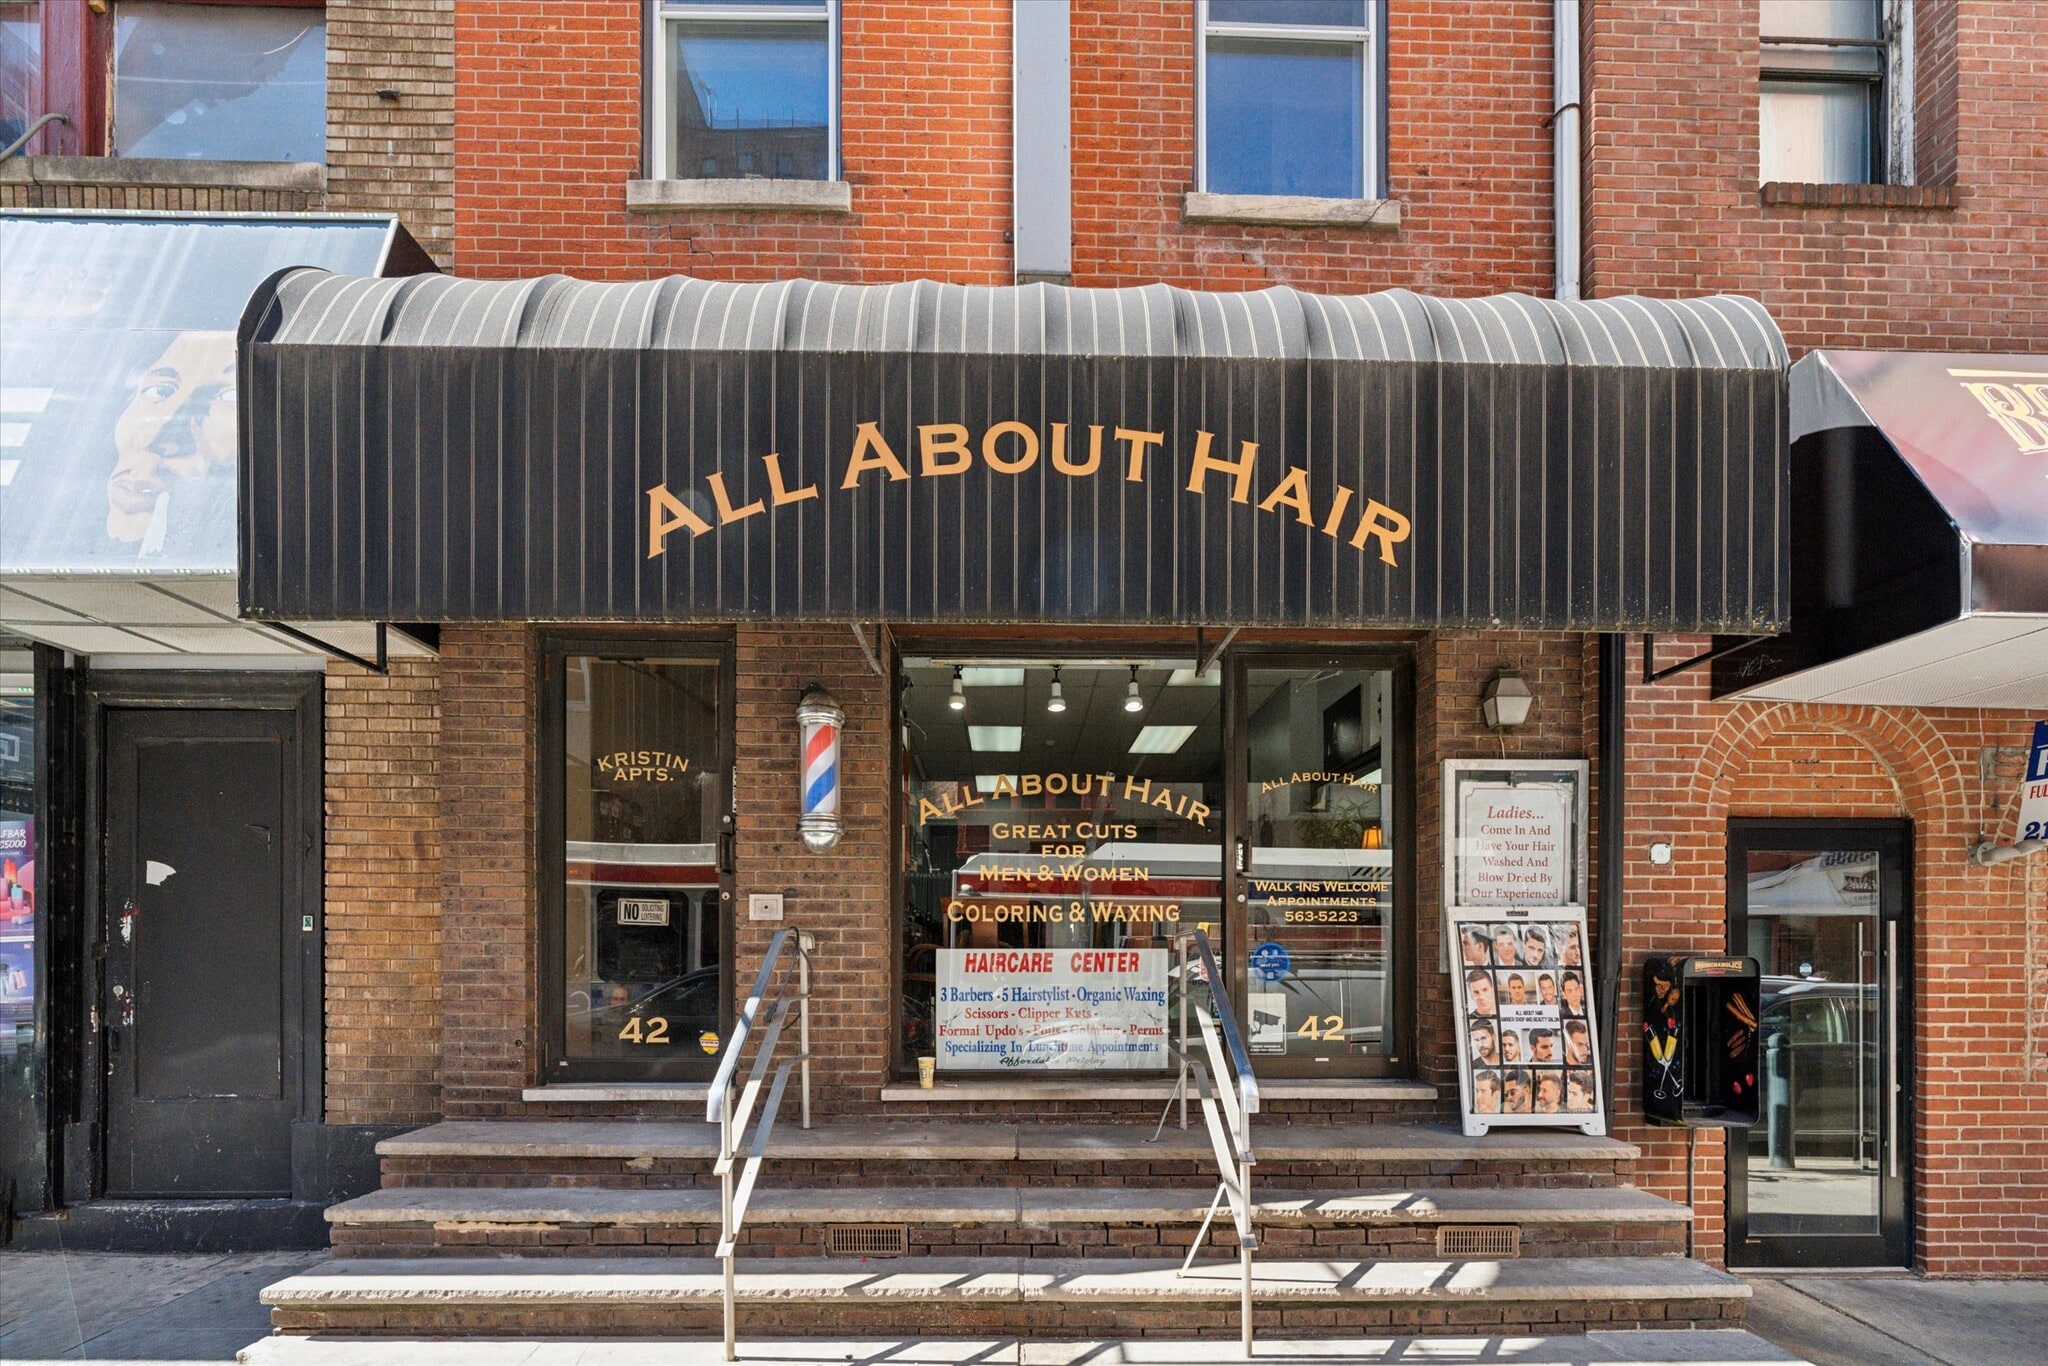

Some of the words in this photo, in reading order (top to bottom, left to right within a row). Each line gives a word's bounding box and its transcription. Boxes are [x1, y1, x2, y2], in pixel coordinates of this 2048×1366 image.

[646, 451, 819, 559] ALL
[840, 420, 1164, 490] ABOUT
[1185, 430, 1411, 567] HAIR
[597, 751, 689, 773] KRISTIN
[613, 767, 675, 782] APTS.
[1261, 777, 1289, 793] ALL
[1291, 772, 1340, 783] ABOUT
[1343, 773, 1378, 793] HAIR
[919, 785, 985, 826] ALL
[992, 772, 1116, 800] ABOUT
[1124, 775, 1211, 827] HAIR
[992, 822, 1071, 839] GREAT
[1076, 822, 1138, 839] CUTS
[1480, 825, 1512, 835] Come
[1515, 825, 1526, 835] In
[1529, 825, 1551, 835] And
[1041, 845, 1086, 858] FOR
[1476, 841, 1502, 851] Have
[1505, 841, 1530, 851] Your
[1532, 841, 1556, 851] Hair
[1483, 857, 1524, 867] Washed
[1526, 857, 1548, 867] And
[980, 865, 1031, 881] MEN
[1039, 864, 1054, 881] &
[1059, 865, 1149, 881] WOMEN
[1478, 872, 1504, 882] Blow
[1507, 872, 1537, 883] Dried
[1540, 873, 1553, 885] By
[1323, 881, 1389, 892] WELCOME
[1471, 888, 1493, 899] Our
[1496, 888, 1559, 901] Experienced
[1266, 897, 1377, 907] APPOINTMENTS
[624, 903, 639, 920] NO
[947, 901, 1063, 923] COLORING
[1069, 902, 1085, 922] &
[1089, 901, 1181, 923] WAXING
[1284, 911, 1358, 922] 563-5223
[964, 952, 1054, 973] HAIRCARE
[1070, 952, 1140, 973] CENTER
[940, 986, 947, 1002] 3
[950, 986, 994, 1002] Barbers
[1002, 986, 1009, 1002] 5
[1011, 985, 1070, 1006] Hairstylist
[1124, 986, 1165, 1007] Waxing
[965, 1007, 1009, 1019] Scissors
[1018, 1007, 1060, 1022] Clipper
[619, 1016, 670, 1044] 42
[985, 1024, 1024, 1039] Updo's
[1129, 1024, 1164, 1036] Perms
[1297, 1015, 1345, 1041] 42
[945, 1040, 1007, 1057] Specializing
[1011, 1041, 1023, 1052] In
[1087, 1040, 1159, 1055] Appointments
